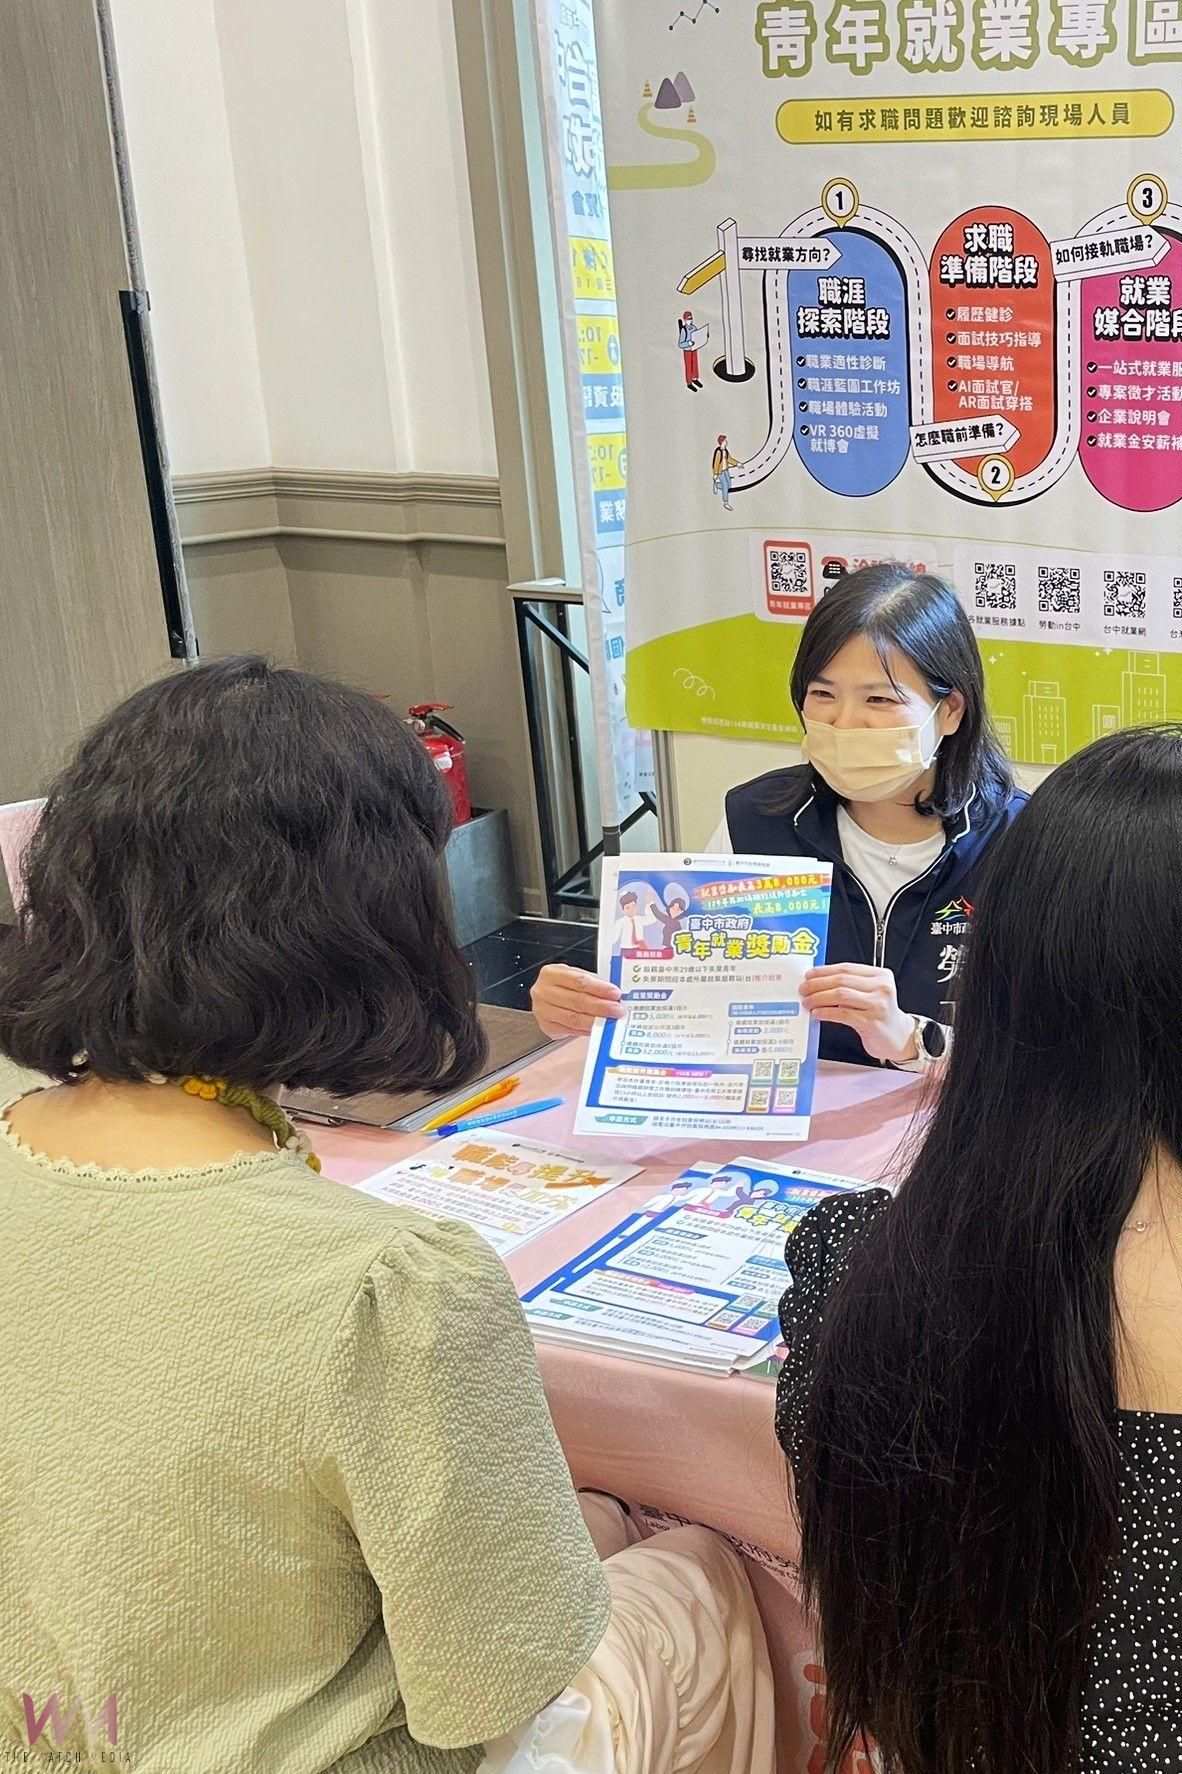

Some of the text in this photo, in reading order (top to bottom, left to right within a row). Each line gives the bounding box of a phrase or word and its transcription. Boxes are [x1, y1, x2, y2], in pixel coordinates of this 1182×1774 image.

[815, 102, 1131, 131] 如有求職問題歡迎諮詢現場人員
[834, 191, 844, 210] 1
[1142, 188, 1153, 208] 3
[963, 224, 1014, 252] 求職
[1056, 234, 1154, 264] 如何接軌職場?
[940, 255, 1039, 285] 準備階段
[818, 278, 865, 304] 職涯
[1120, 276, 1171, 306] 就業
[798, 307, 889, 335] 探索階段
[957, 307, 1013, 322] 履歷健診
[957, 332, 1041, 348] 面試技巧指導
[806, 354, 886, 370] 職業適性診斷
[958, 355, 1014, 371] 職場導航
[808, 378, 900, 394] 職涯藍圖工作坊
[959, 380, 1019, 396] AI面試官/
[808, 401, 887, 417] 職場體驗活動
[959, 395, 1033, 411] AR面試穿搭
[1098, 410, 1170, 426] 企業說明會
[810, 425, 879, 440] VR 360虛擬
[915, 423, 1004, 447] 怎麼職前準備?
[811, 439, 849, 454] 就博會
[991, 466, 1000, 485] 2
[1103, 624, 1146, 637] 台中就業網
